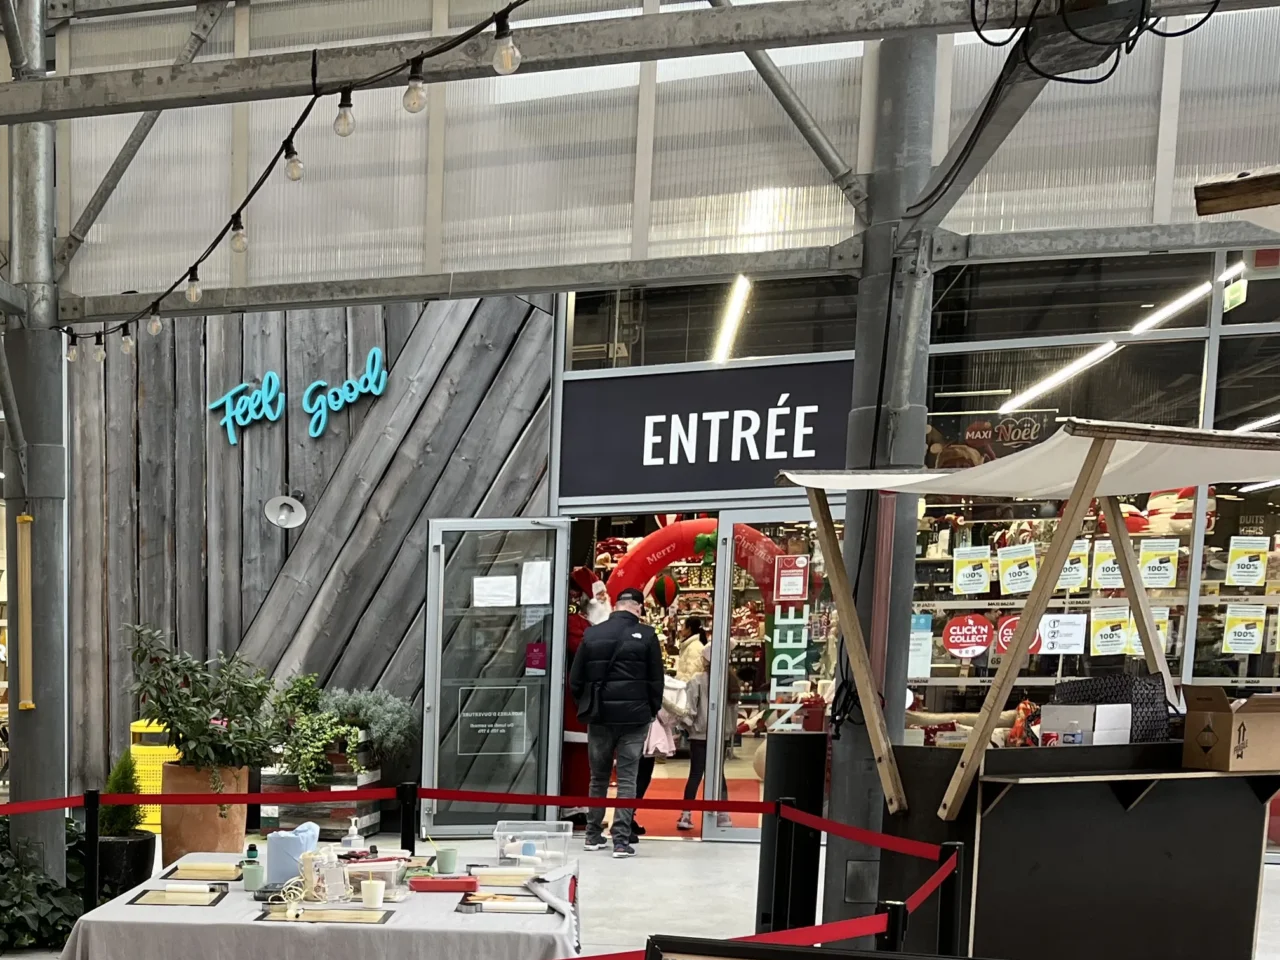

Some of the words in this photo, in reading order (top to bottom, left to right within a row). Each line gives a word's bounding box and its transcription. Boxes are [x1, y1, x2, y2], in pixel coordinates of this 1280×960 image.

[208, 371, 285, 445] Feel
[302, 347, 388, 438] Good
[643, 393, 818, 466] ENTRÉE
[965, 430, 992, 440] MAXI
[995, 423, 1041, 441] Noël
[646, 542, 677, 565] Merry
[734, 534, 775, 564] Christmas
[1008, 570, 1029, 578] 100%
[949, 625, 988, 635] CLICK'N
[949, 635, 988, 643] COLLECT
[765, 604, 810, 731] NTRÉE
